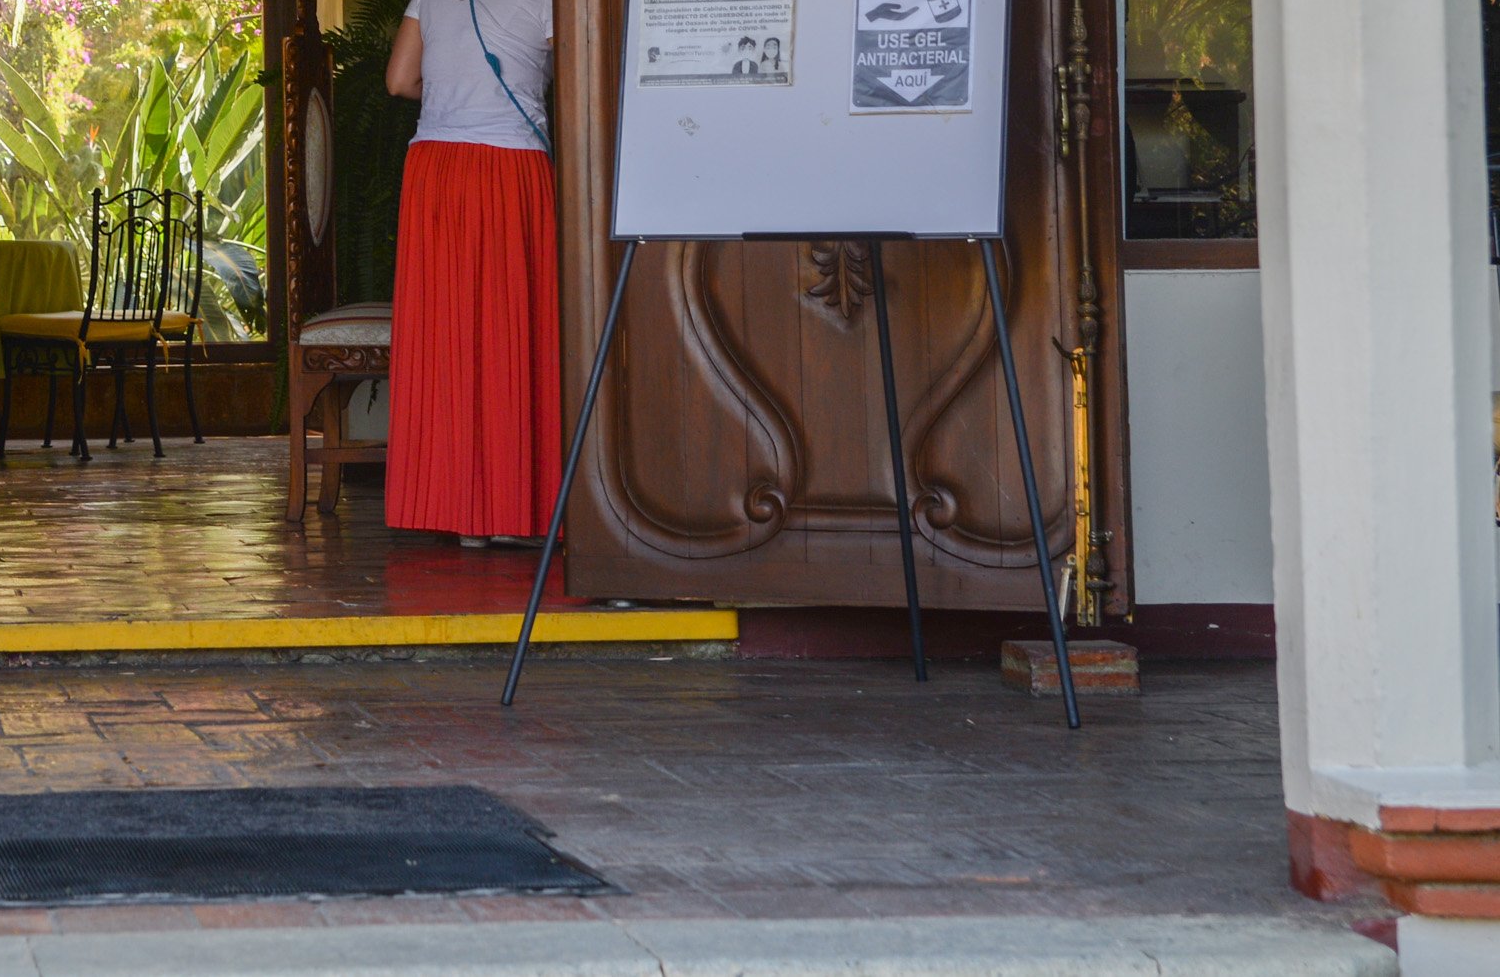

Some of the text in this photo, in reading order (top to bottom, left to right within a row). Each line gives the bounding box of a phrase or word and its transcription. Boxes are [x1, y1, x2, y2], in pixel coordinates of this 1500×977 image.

[877, 31, 946, 48] USE GEL
[856, 50, 967, 66] ANTIBACTERIAL
[894, 71, 927, 88] AQUÍ
